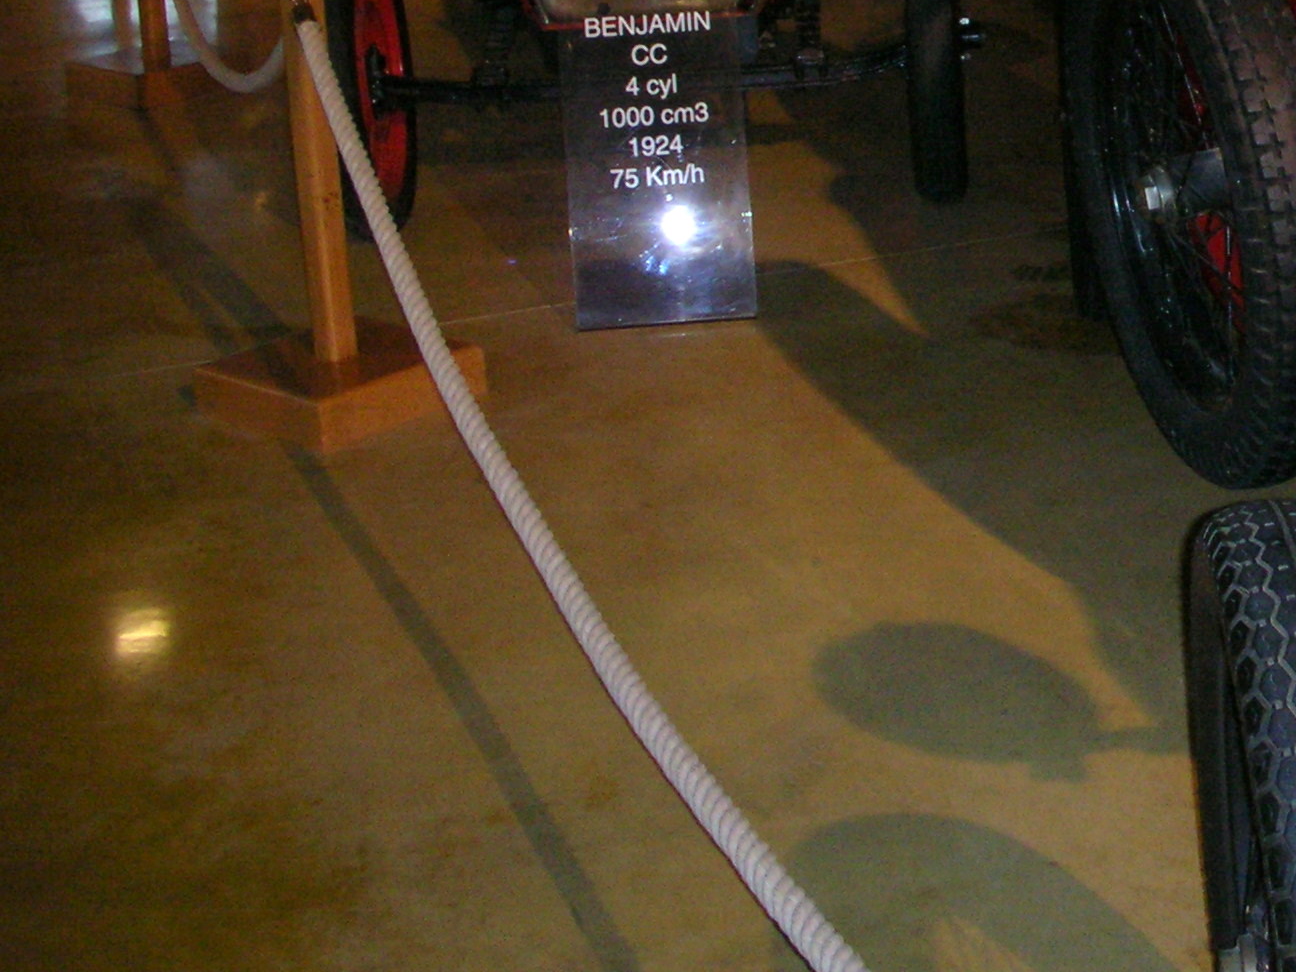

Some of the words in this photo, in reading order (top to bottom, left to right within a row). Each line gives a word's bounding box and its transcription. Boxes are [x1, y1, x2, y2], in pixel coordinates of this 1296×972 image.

[584, 10, 712, 38] BENJAMIN
[631, 43, 668, 66] CC
[625, 76, 640, 96] 4
[646, 73, 678, 99] cyl
[600, 106, 655, 128] 1000
[660, 102, 710, 125] cm3
[628, 134, 684, 157] 1924
[610, 168, 640, 190] 75
[646, 163, 705, 187] Km/h
